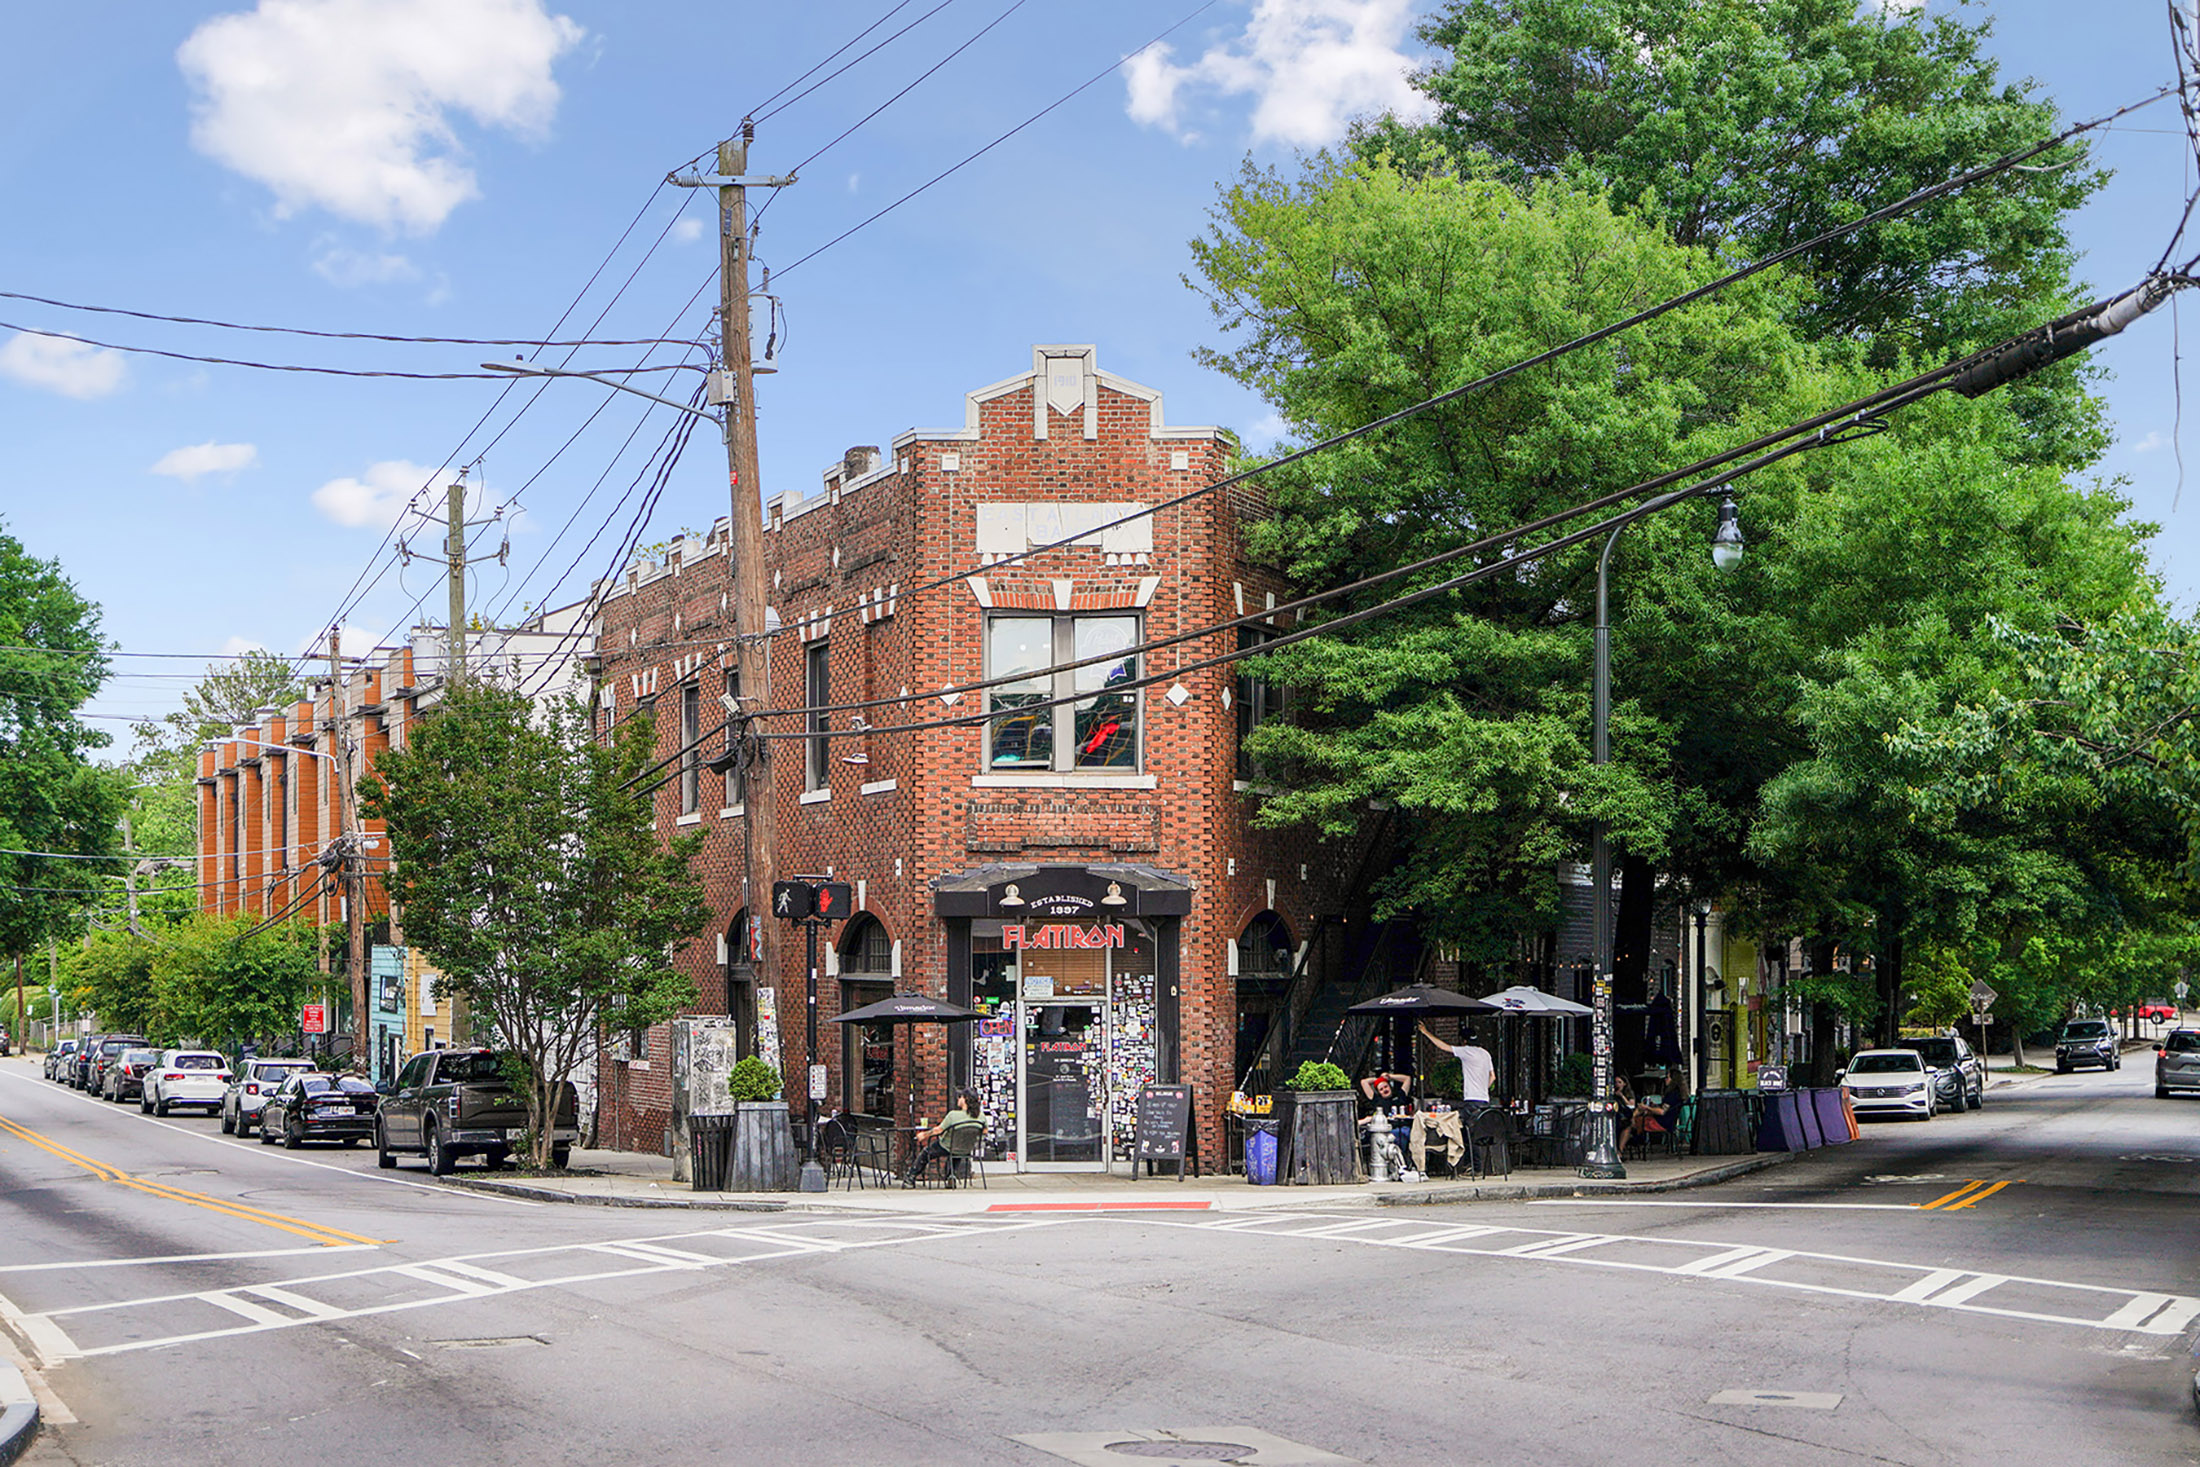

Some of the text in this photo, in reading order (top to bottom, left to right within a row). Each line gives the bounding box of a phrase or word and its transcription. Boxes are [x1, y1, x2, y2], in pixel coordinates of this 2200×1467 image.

[983, 507, 1139, 521] EAST ATLANT
[1030, 895, 1094, 909] ESTABLISHED
[1001, 924, 1124, 949] FLATIRON
[982, 1020, 1013, 1035] OPEN
[1040, 1041, 1087, 1052] FLATIRON
